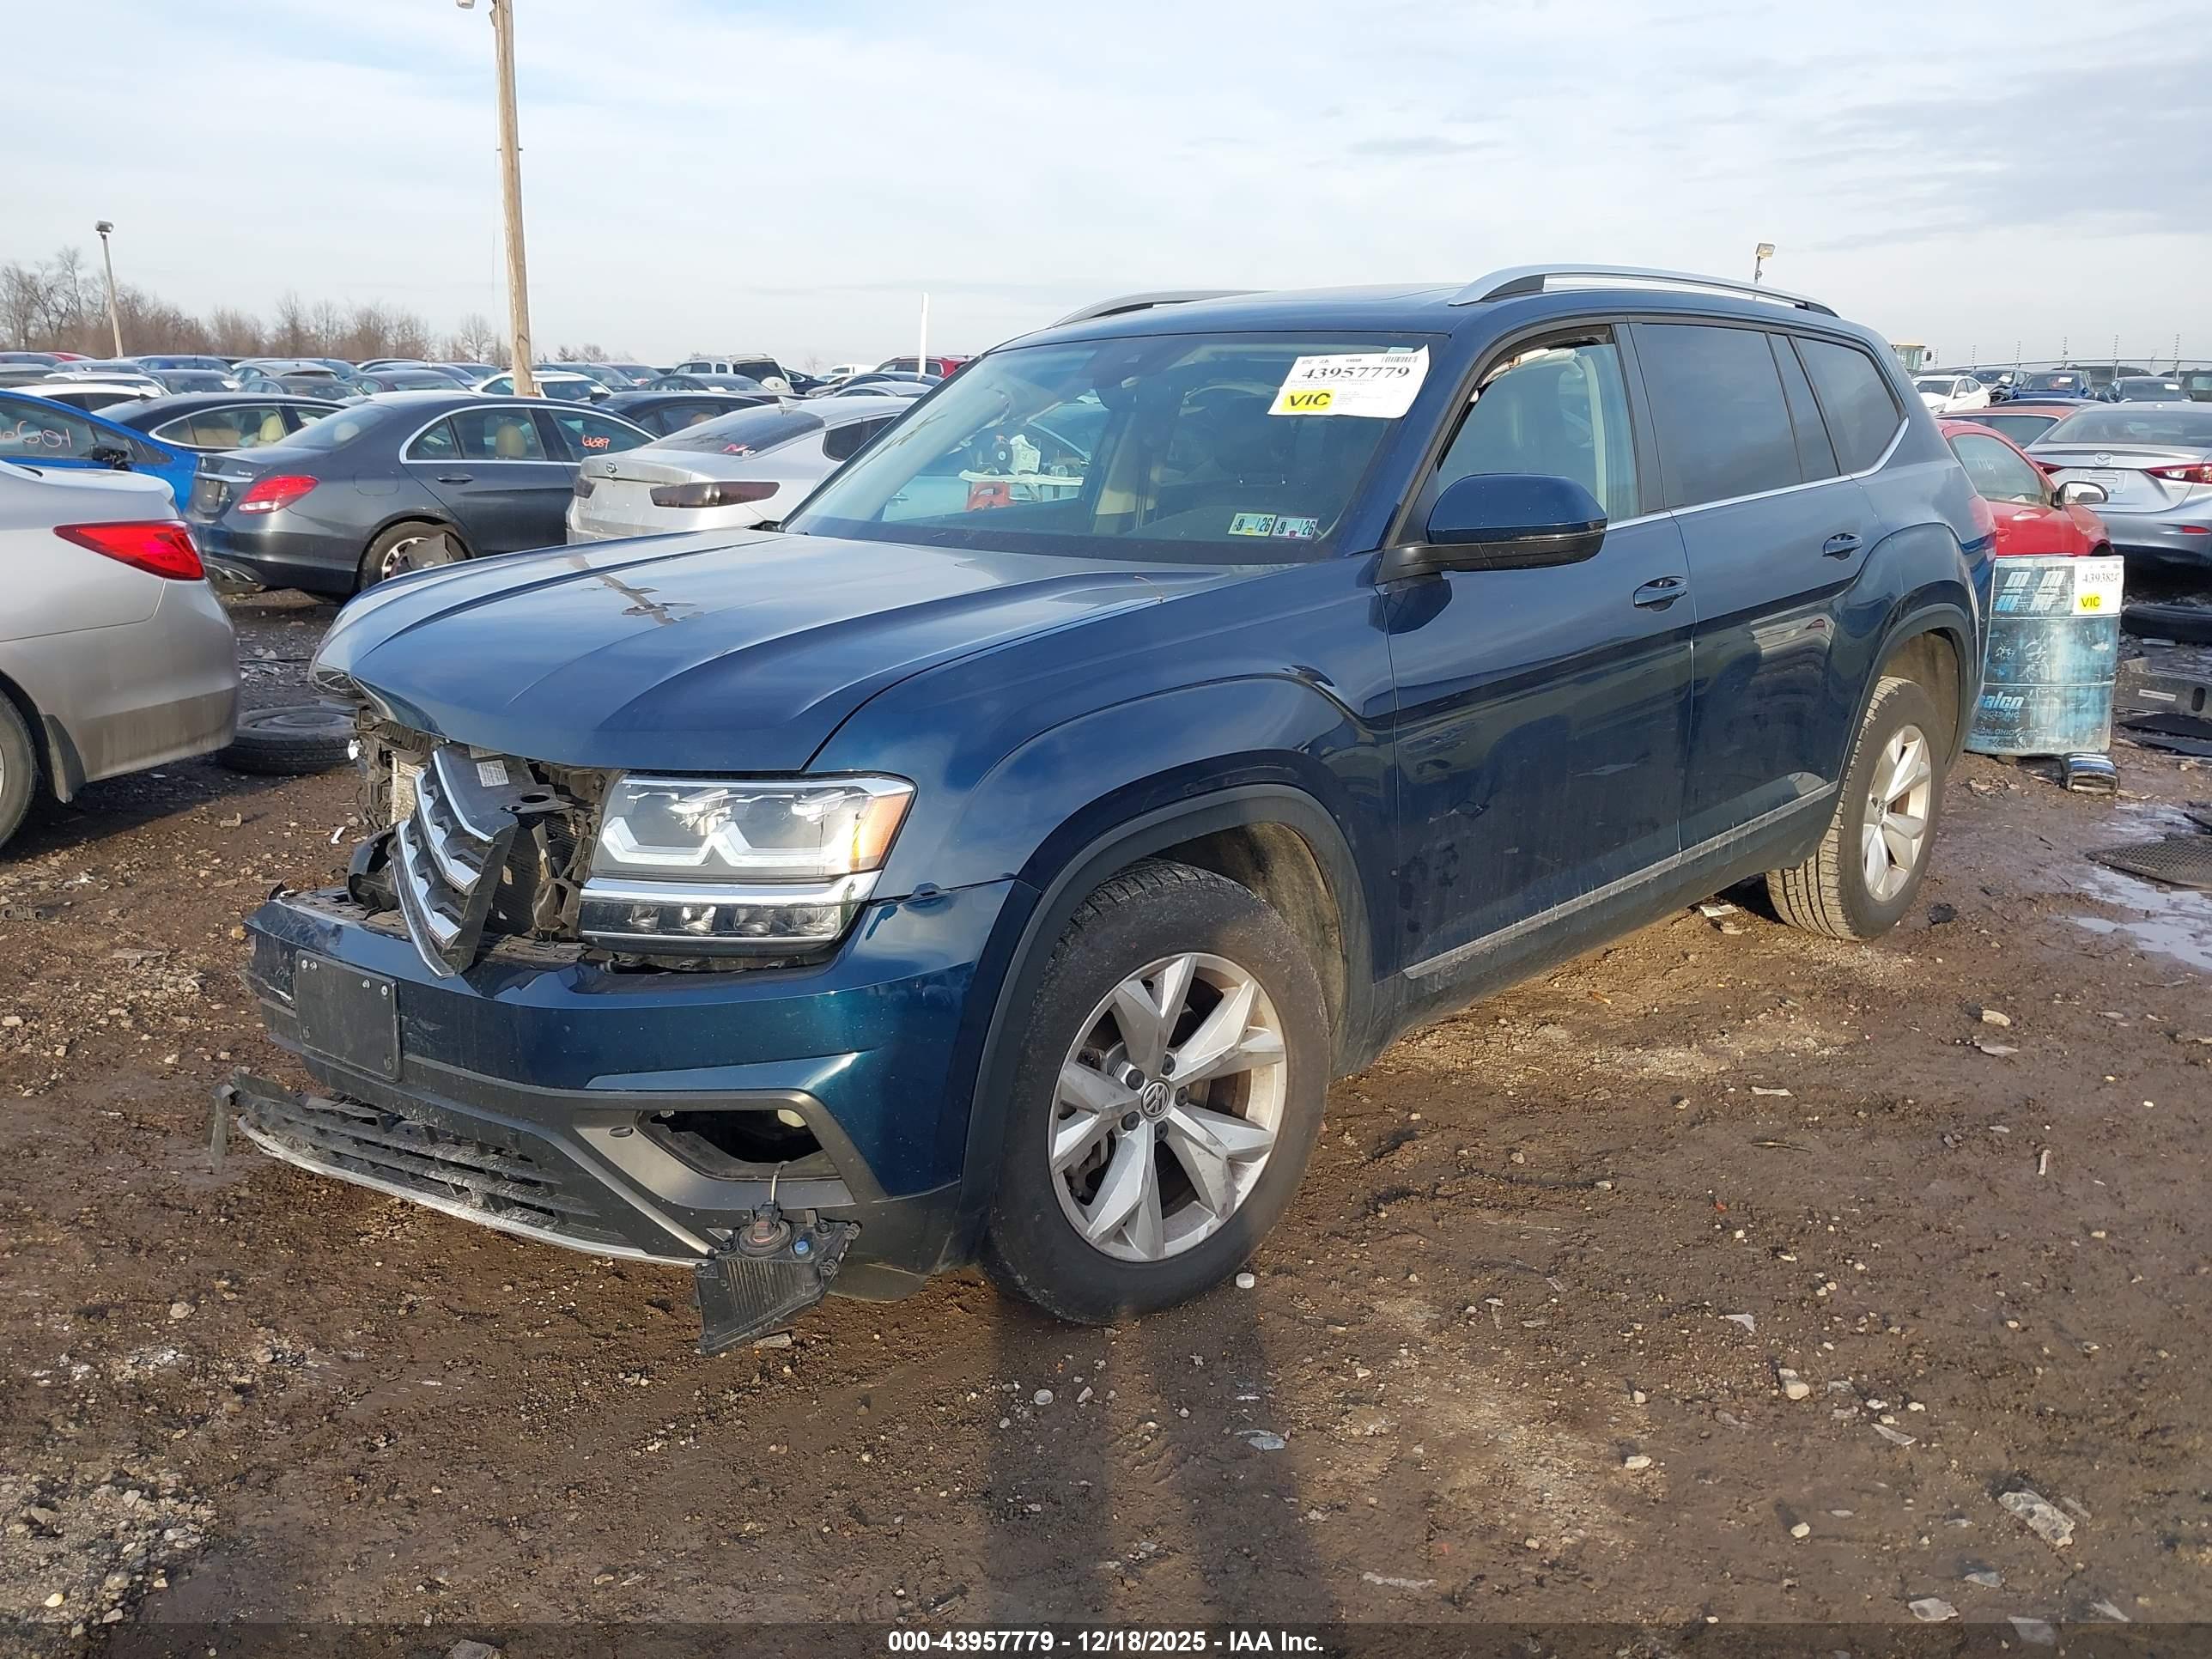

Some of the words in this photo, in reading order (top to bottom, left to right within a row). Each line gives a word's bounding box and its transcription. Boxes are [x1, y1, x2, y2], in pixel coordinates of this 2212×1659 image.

[1302, 367, 1410, 379] 43957779
[1290, 392, 1331, 407] VIC
[1259, 517, 1273, 532] 26
[1302, 520, 1316, 536] 26
[2081, 596, 2100, 608] VIC
